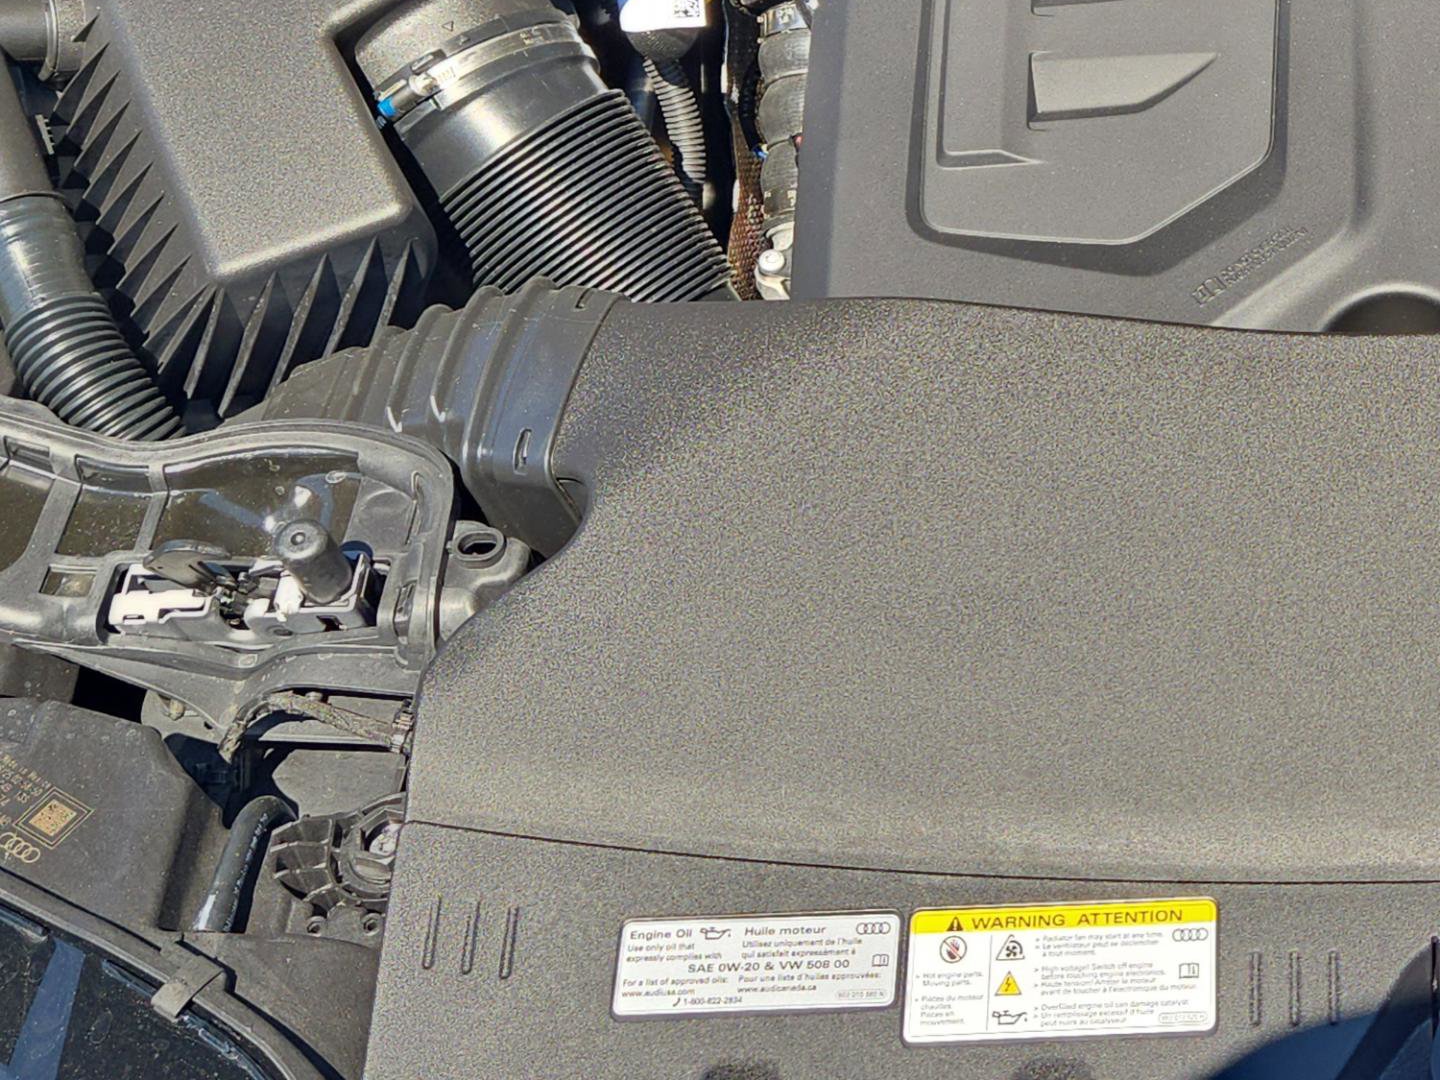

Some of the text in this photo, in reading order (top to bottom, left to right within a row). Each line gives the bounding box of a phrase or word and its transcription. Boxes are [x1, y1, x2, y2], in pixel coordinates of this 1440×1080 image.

[972, 909, 1184, 929] WARNING ATTENTION
[630, 929, 692, 940] Engine Oil
[744, 926, 826, 936] Huile moteur
[688, 959, 850, 973] SAE 0W-20 & VW 508 00
